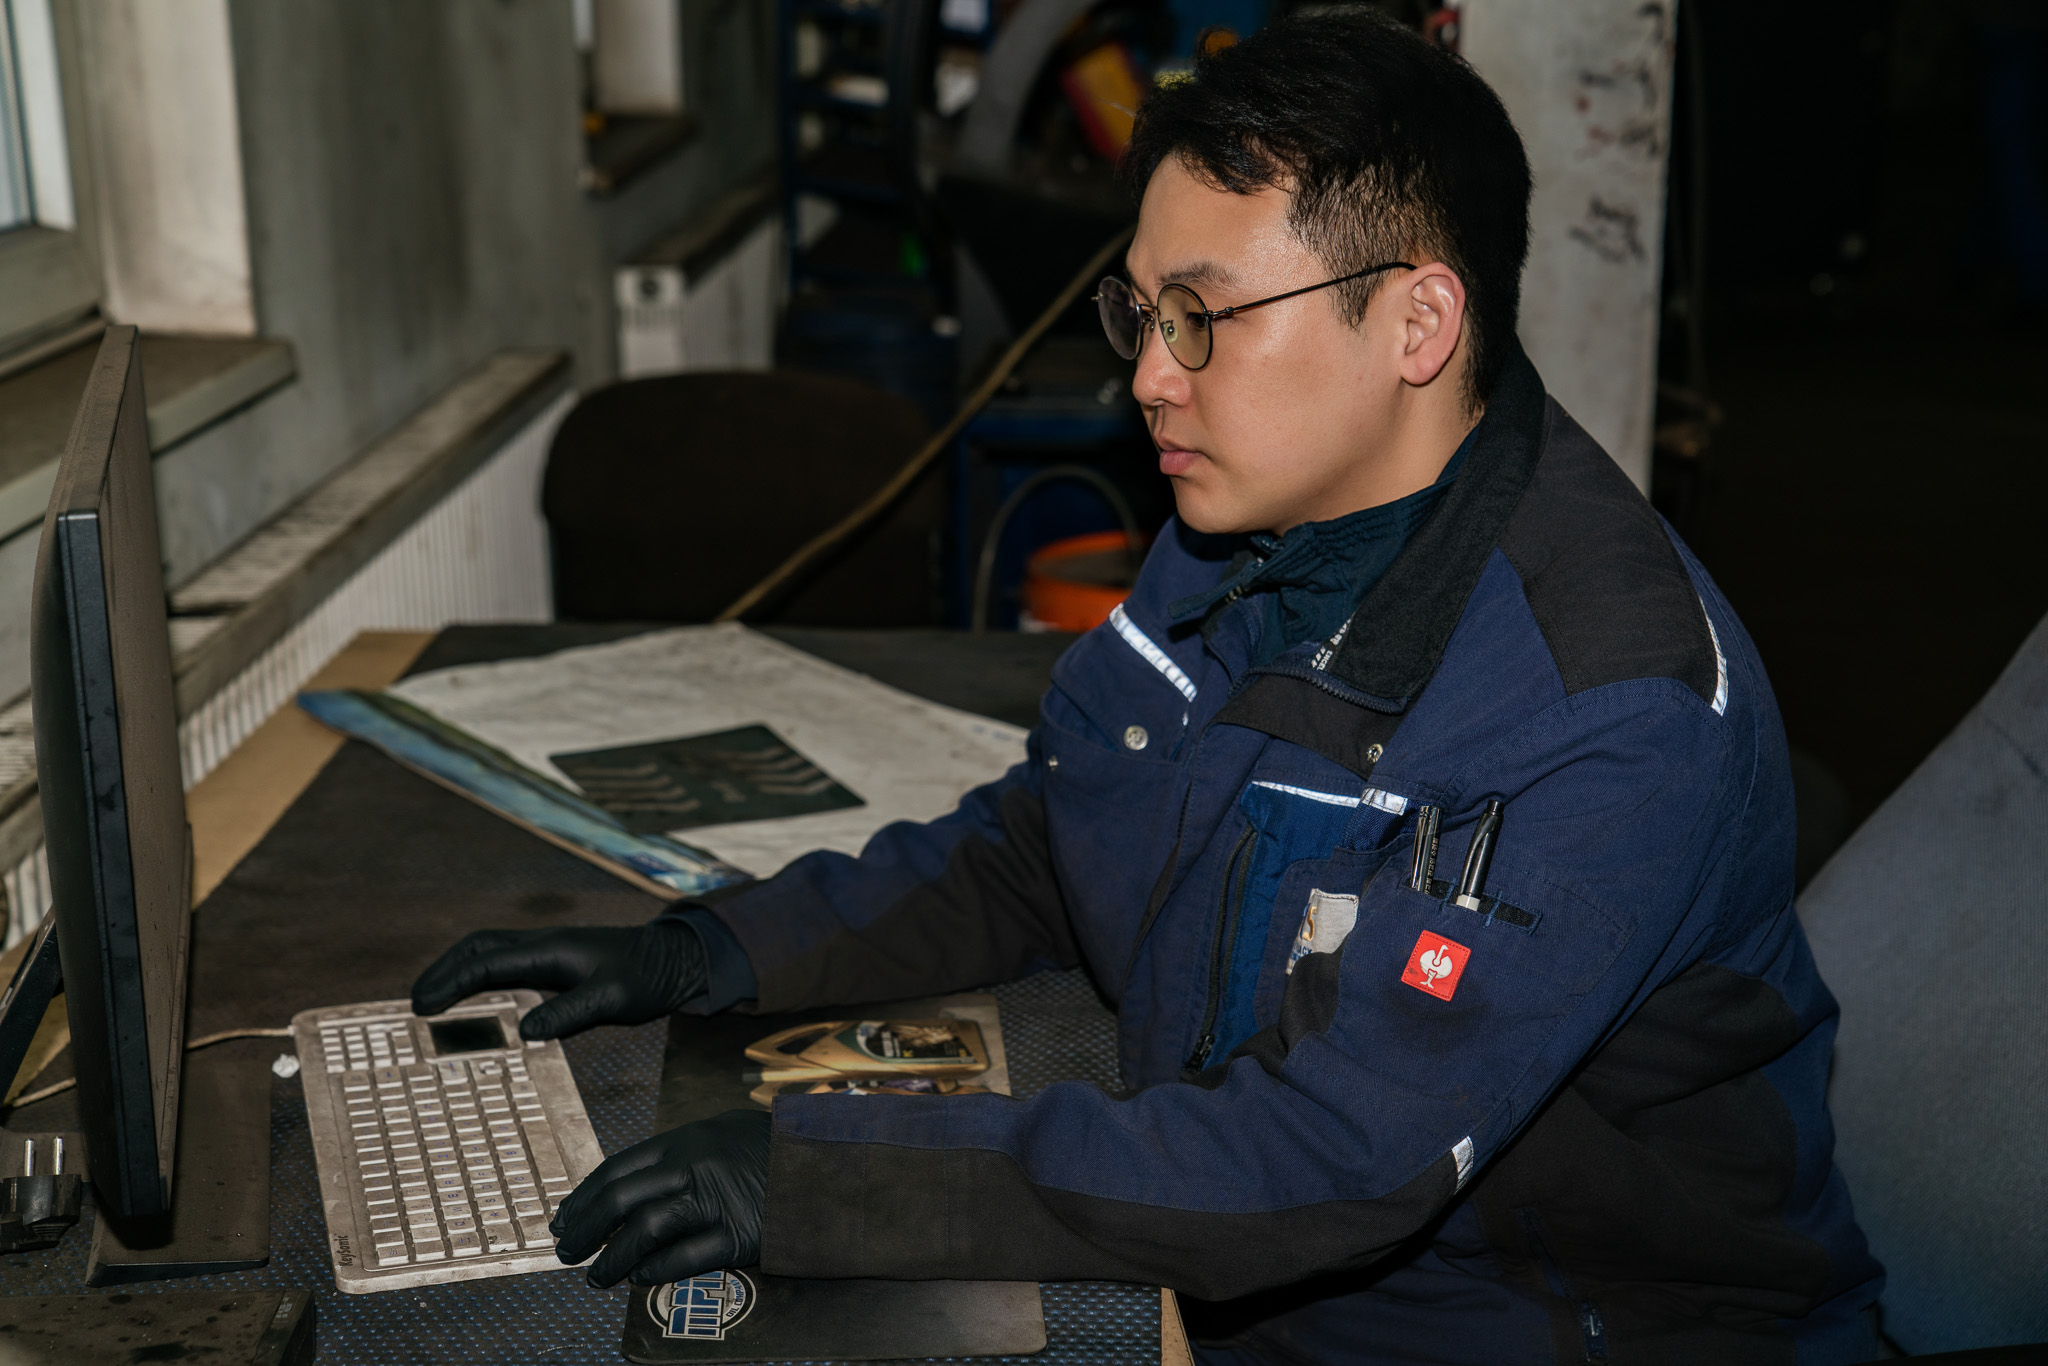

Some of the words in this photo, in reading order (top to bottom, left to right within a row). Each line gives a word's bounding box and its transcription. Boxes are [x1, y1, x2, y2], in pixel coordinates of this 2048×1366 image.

[334, 1235, 356, 1267] KeySonic
[730, 1279, 744, 1306] COMPANY
[725, 1307, 740, 1318] OIL
